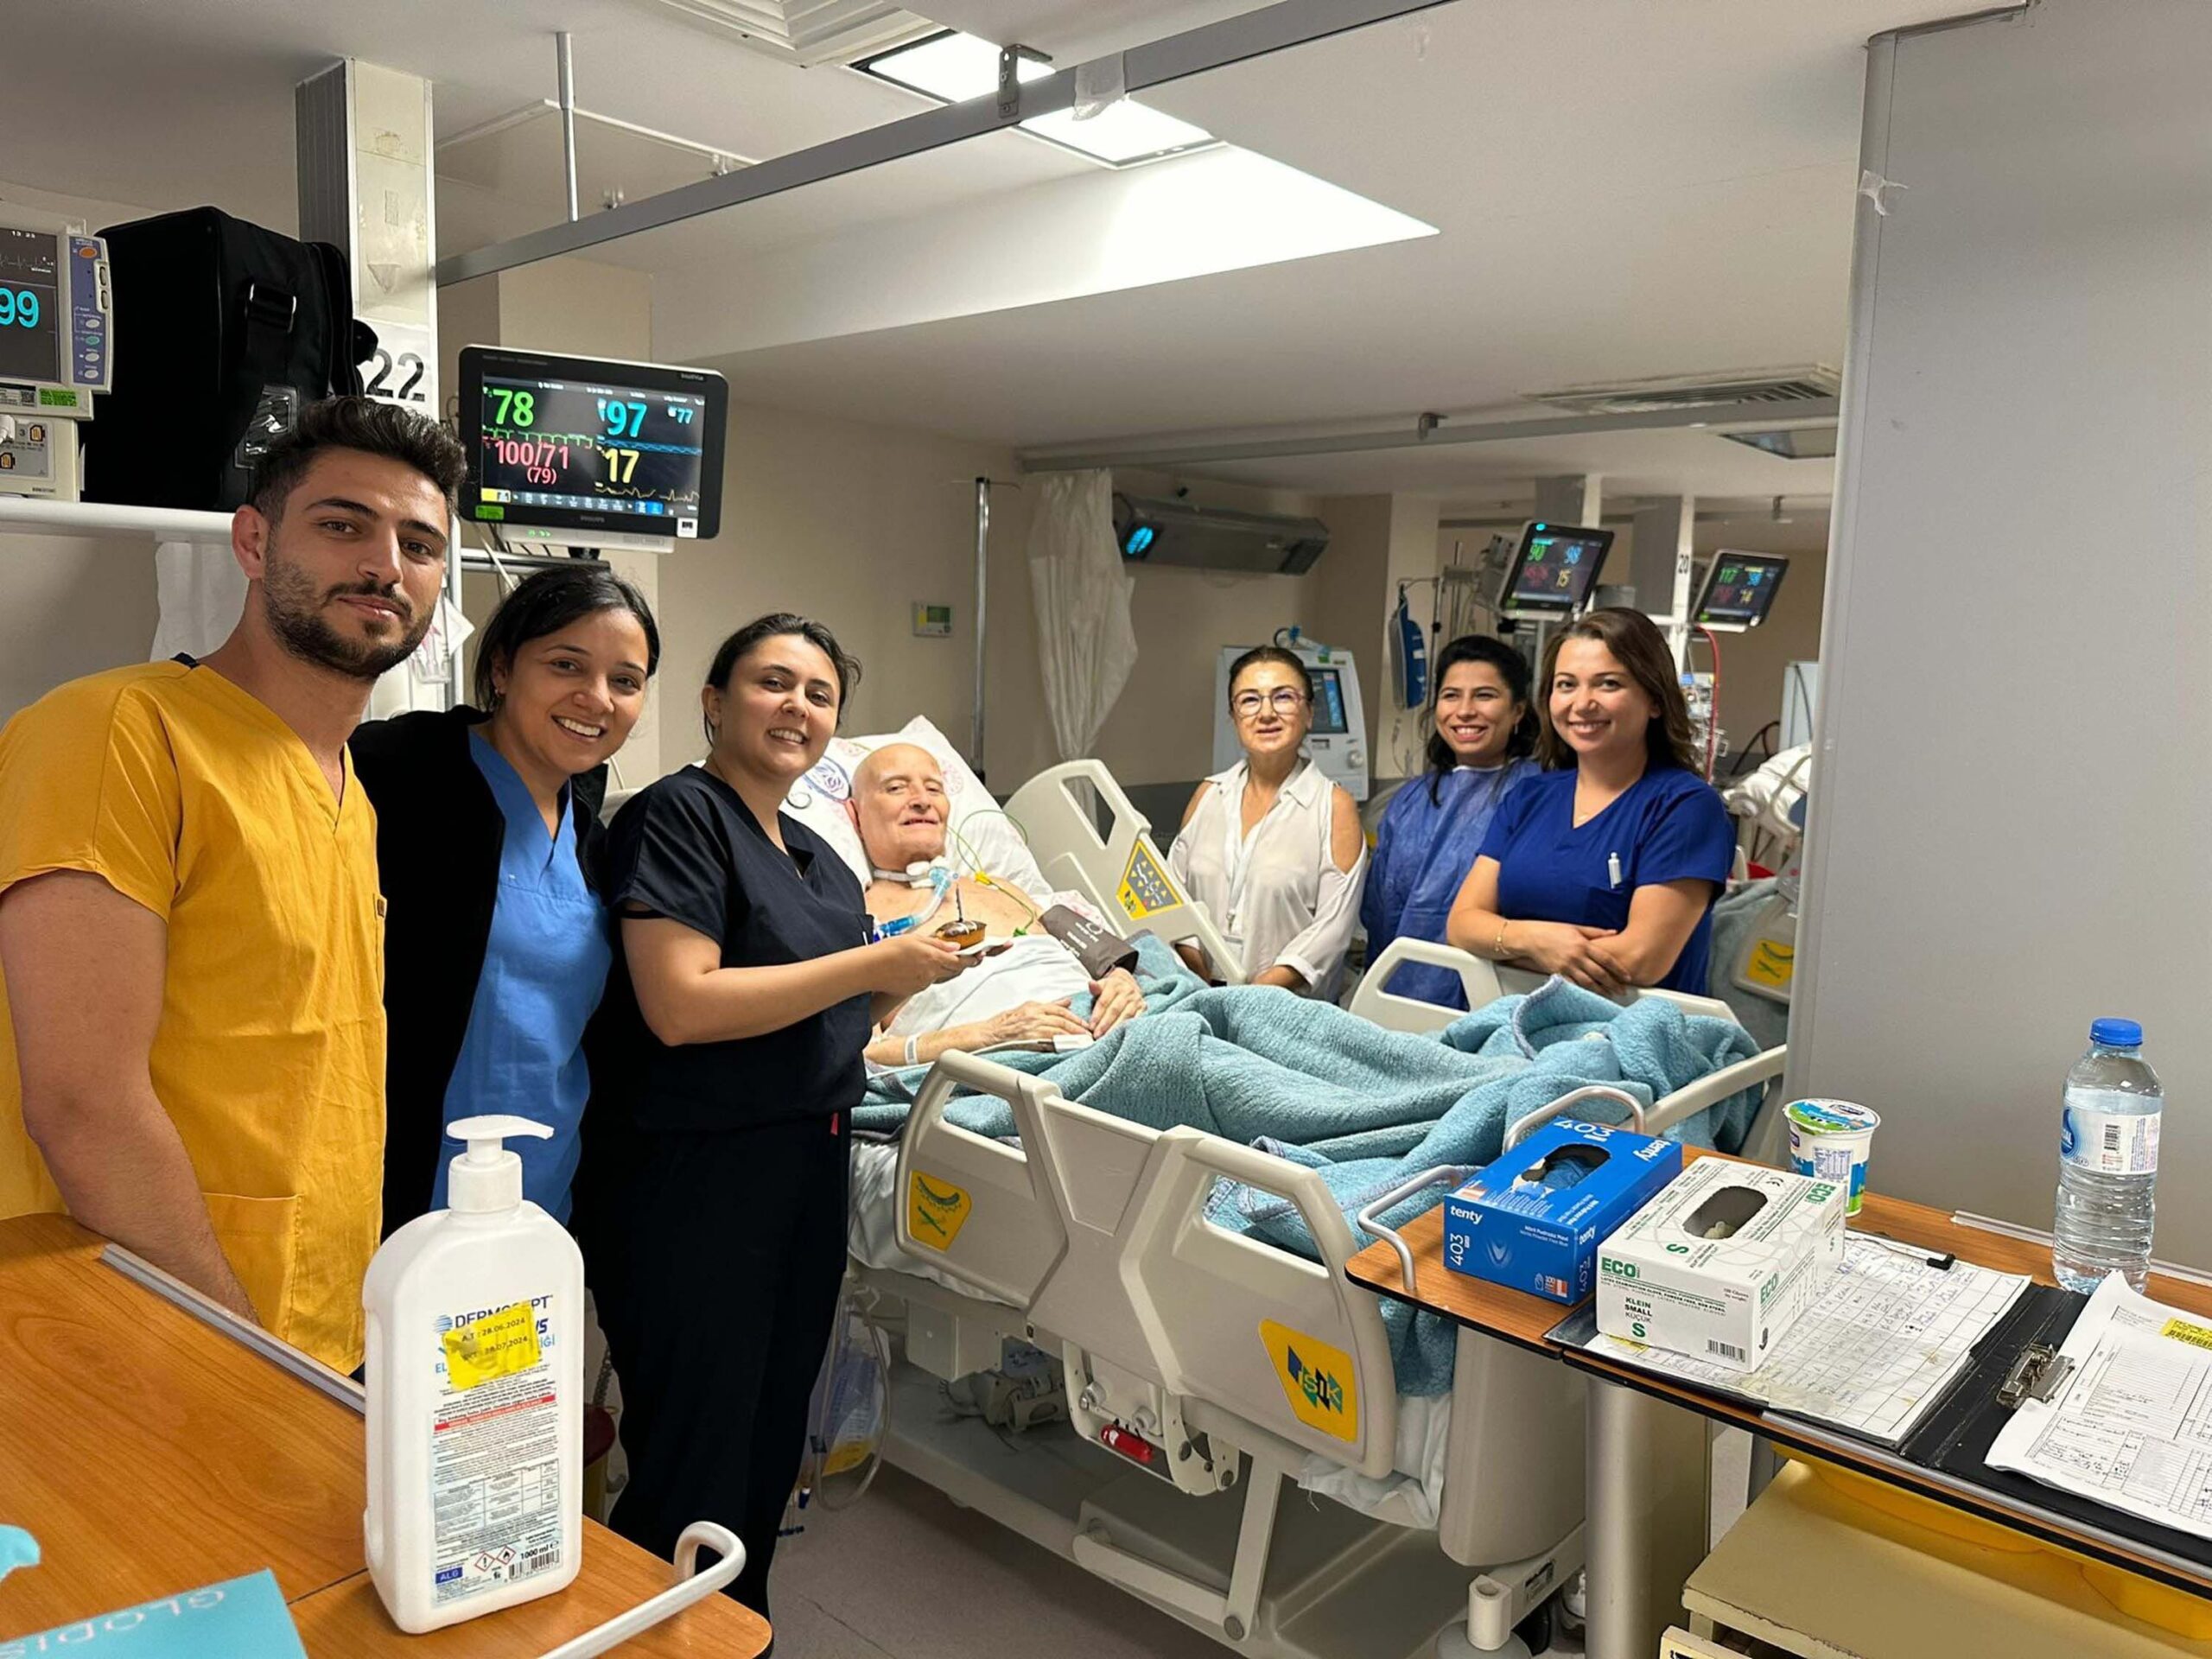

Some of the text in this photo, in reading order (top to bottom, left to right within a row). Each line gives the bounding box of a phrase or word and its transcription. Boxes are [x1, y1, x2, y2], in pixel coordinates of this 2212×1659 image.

[0, 288, 40, 327] 99
[365, 347, 425, 402] 22
[493, 389, 534, 427] 78
[607, 400, 647, 438] 97
[495, 440, 569, 469] 100/71
[527, 467, 557, 484] (79)
[605, 448, 639, 484] 17
[1678, 554, 1690, 574] 20
[1554, 1119, 1616, 1138] 403
[1632, 1139, 1672, 1162] tenty
[1806, 1182, 1836, 1203] ECO
[1450, 1205, 1483, 1225] tenty
[1450, 1232, 1464, 1266] 403
[1666, 1243, 1689, 1254] S
[1602, 1256, 1636, 1277] ECO
[1760, 1272, 1779, 1304] ECO
[455, 1296, 550, 1328] DERPT
[1624, 1304, 1652, 1317] SMALL
[1625, 1296, 1651, 1308] KLEIN
[482, 1318, 525, 1337] 28.06.2024
[1632, 1322, 1646, 1338] S
[520, 1544, 549, 1560] 1000 ml
